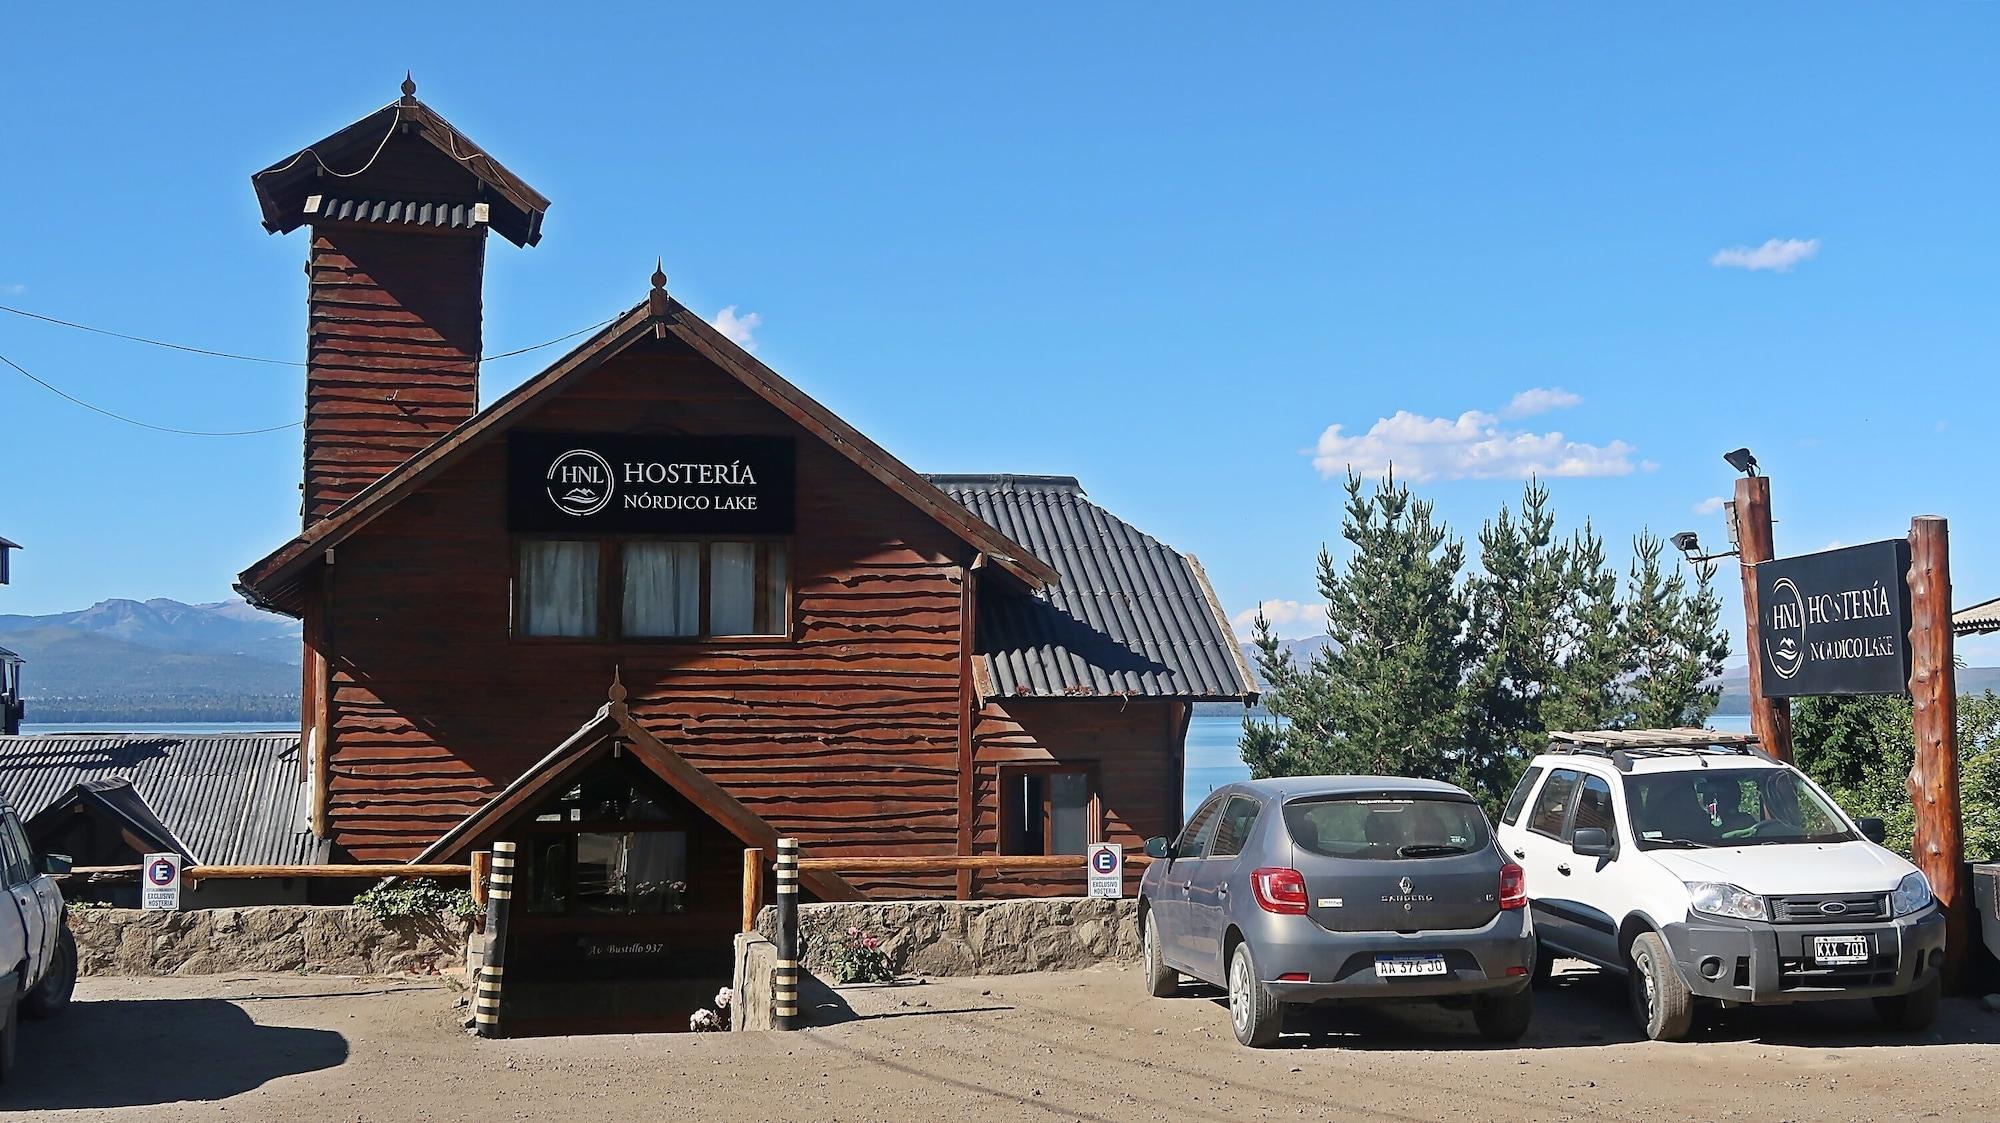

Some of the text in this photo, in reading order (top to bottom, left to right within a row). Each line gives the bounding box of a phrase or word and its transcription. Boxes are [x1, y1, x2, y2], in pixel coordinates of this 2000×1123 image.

[561, 466, 604, 484] HNL
[623, 460, 757, 485] HOSTERÍA
[623, 491, 758, 510] NÓRDICO LAKE
[1773, 603, 1800, 630] HNL
[1099, 854, 1111, 870] E
[155, 864, 168, 881] E
[607, 942, 644, 954] Bustillo
[645, 943, 664, 954] 937
[1817, 942, 1866, 957] KXX 701
[1381, 960, 1443, 974] AA 376 JO
